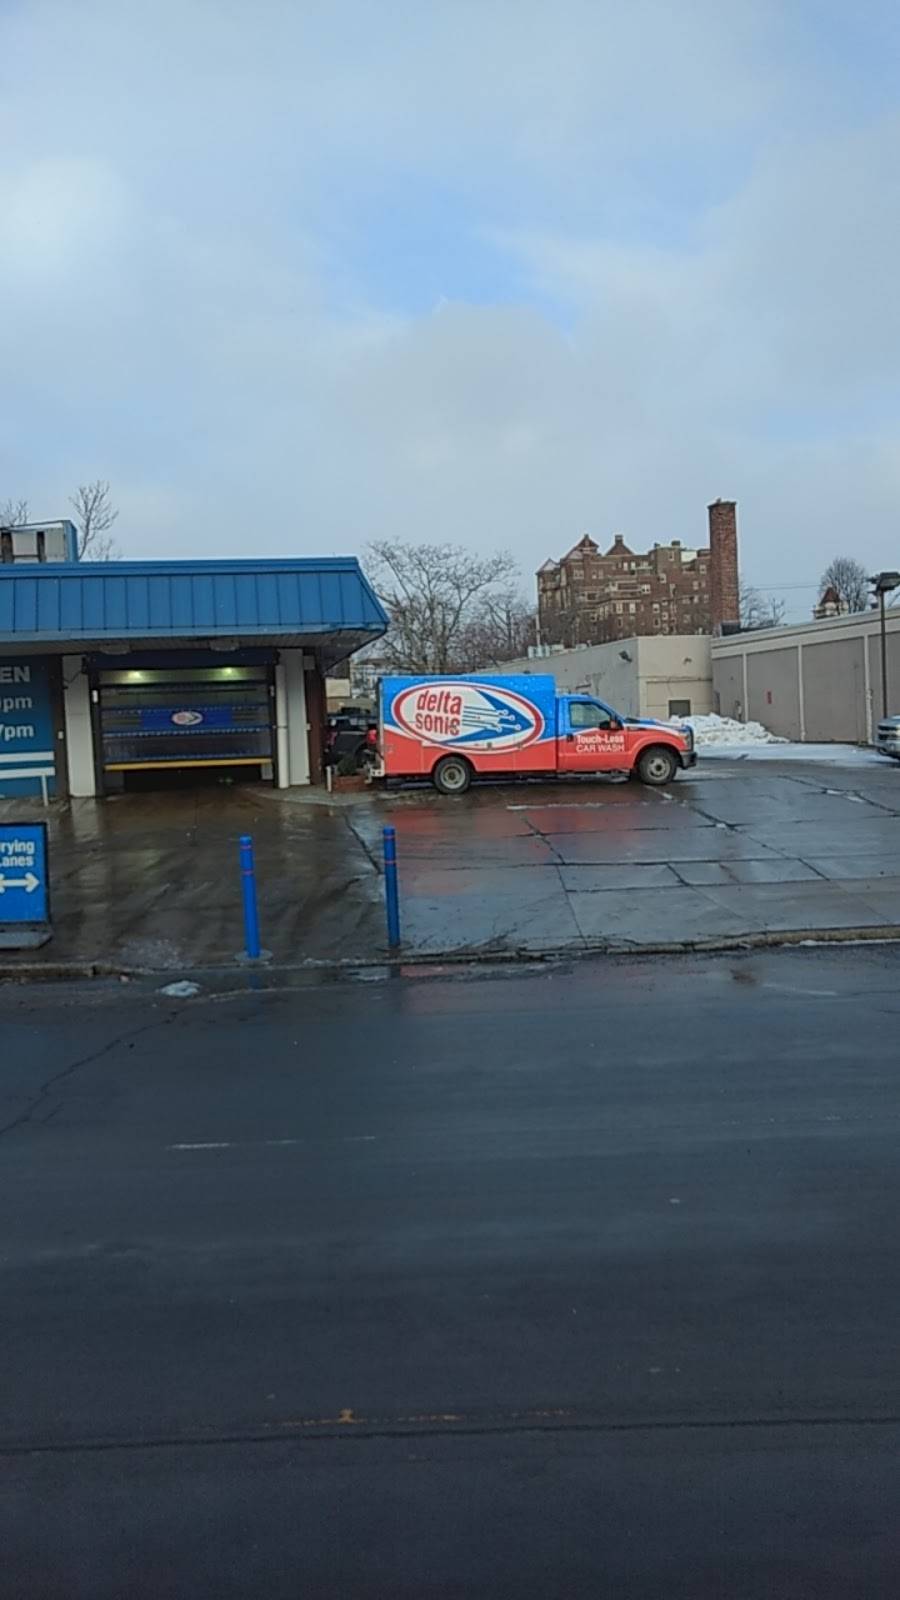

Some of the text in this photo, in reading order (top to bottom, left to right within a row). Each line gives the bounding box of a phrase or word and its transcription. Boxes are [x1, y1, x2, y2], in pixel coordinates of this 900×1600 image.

[0, 697, 32, 713] pm
[417, 690, 462, 715] delta
[576, 743, 625, 753] CAR WASH
[0, 855, 34, 868] anes
